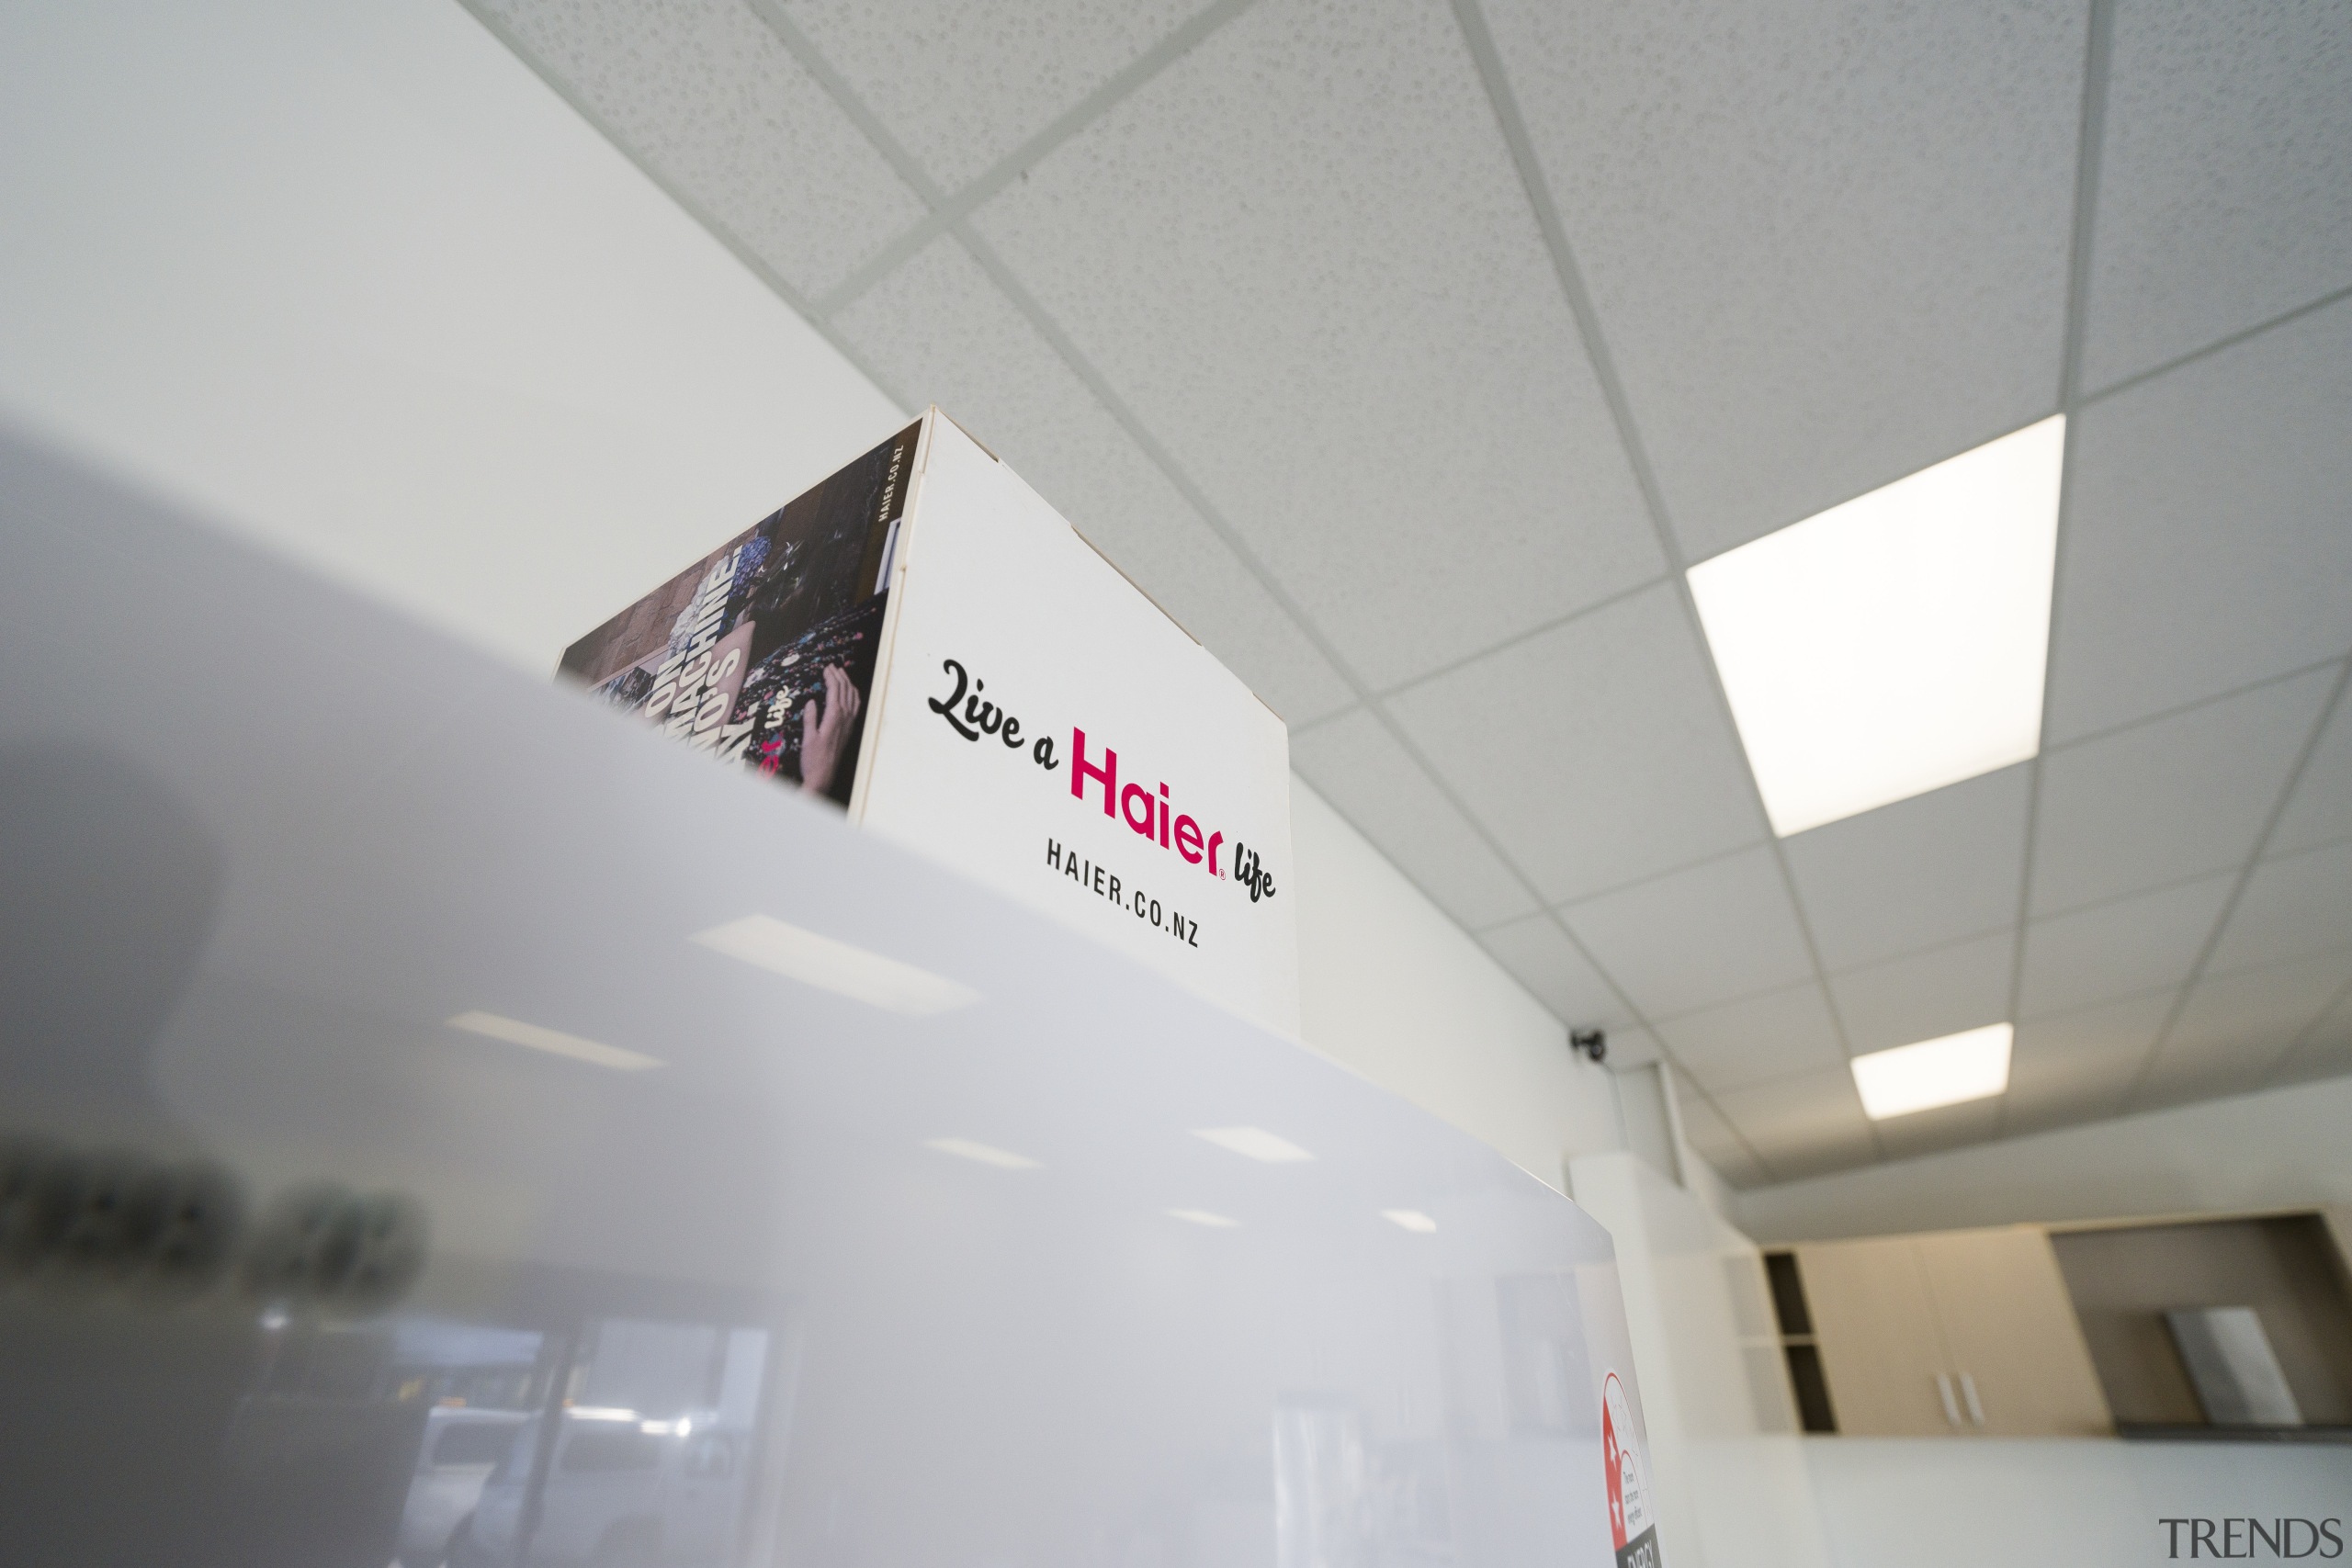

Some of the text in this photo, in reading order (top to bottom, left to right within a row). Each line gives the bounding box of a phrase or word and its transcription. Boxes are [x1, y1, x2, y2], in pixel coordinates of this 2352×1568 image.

[878, 445, 904, 523] HAIER.CO.NZ
[644, 649, 687, 718] ON
[765, 685, 796, 730] life
[928, 659, 1024, 749] Live
[1033, 736, 1058, 771] a
[1234, 841, 1276, 904] life
[1046, 837, 1199, 949] HAIER.CO.NZ
